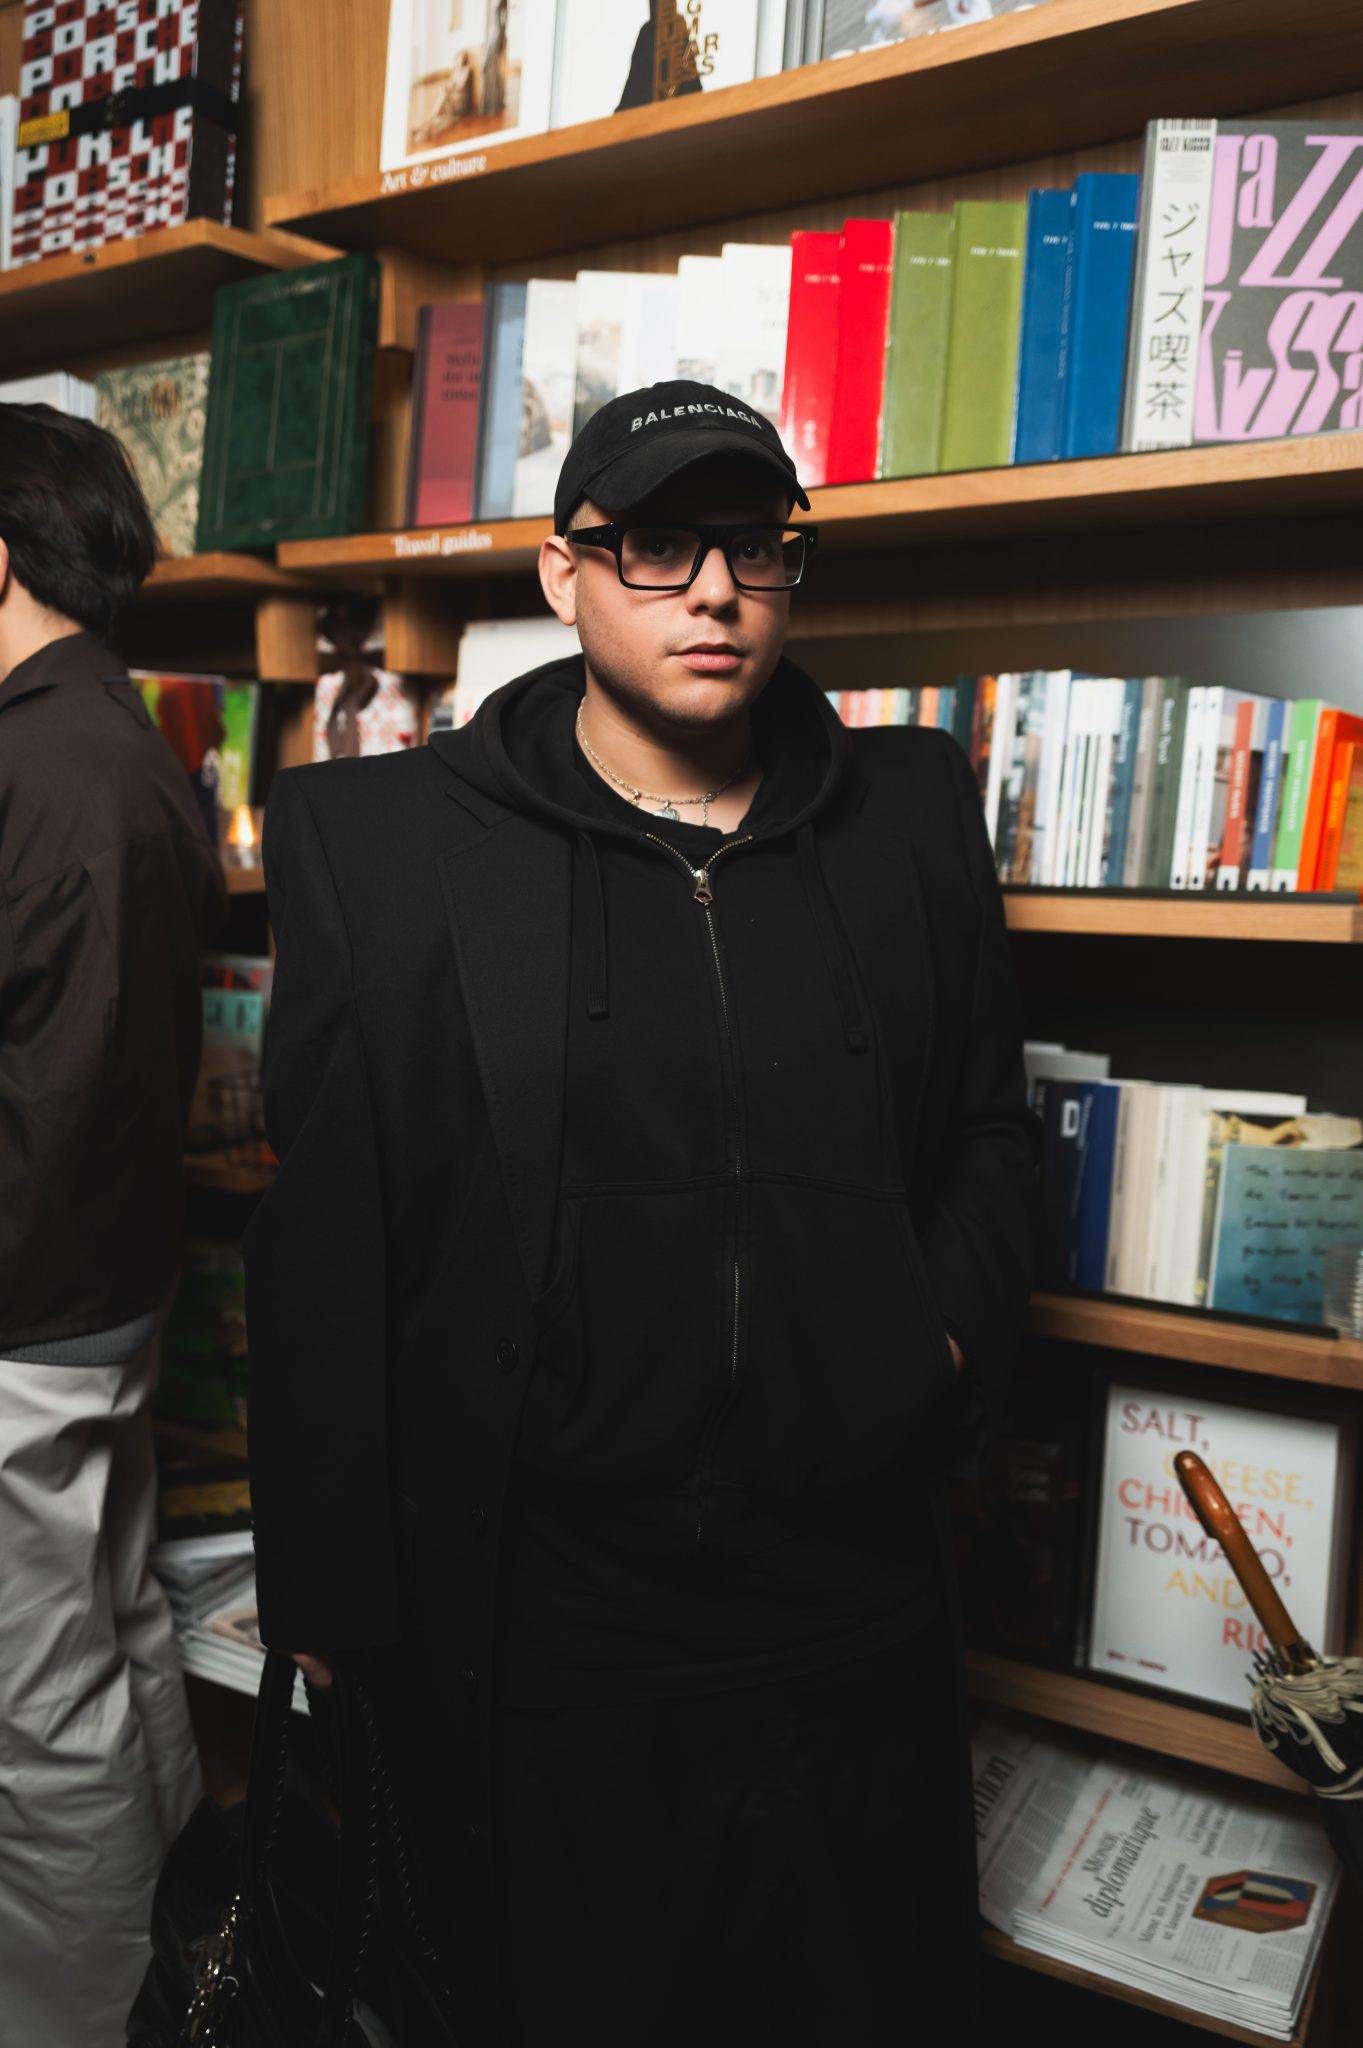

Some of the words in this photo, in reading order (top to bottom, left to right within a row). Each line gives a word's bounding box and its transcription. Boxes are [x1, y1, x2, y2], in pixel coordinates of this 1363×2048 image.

[381, 172, 408, 193] Art
[410, 164, 429, 186] &
[430, 155, 487, 182] culture
[1145, 202, 1201, 421] ジャズ喫茶
[630, 403, 762, 432] BALENCIAGA
[393, 533, 440, 557] Travel
[441, 528, 492, 556] guides
[1120, 1403, 1210, 1451] SALT,
[1163, 1450, 1314, 1511] EESE,
[1118, 1478, 1293, 1548] CHIEN,
[1125, 1516, 1291, 1587] TOMO,
[1083, 1805, 1161, 1919] diplomatique
